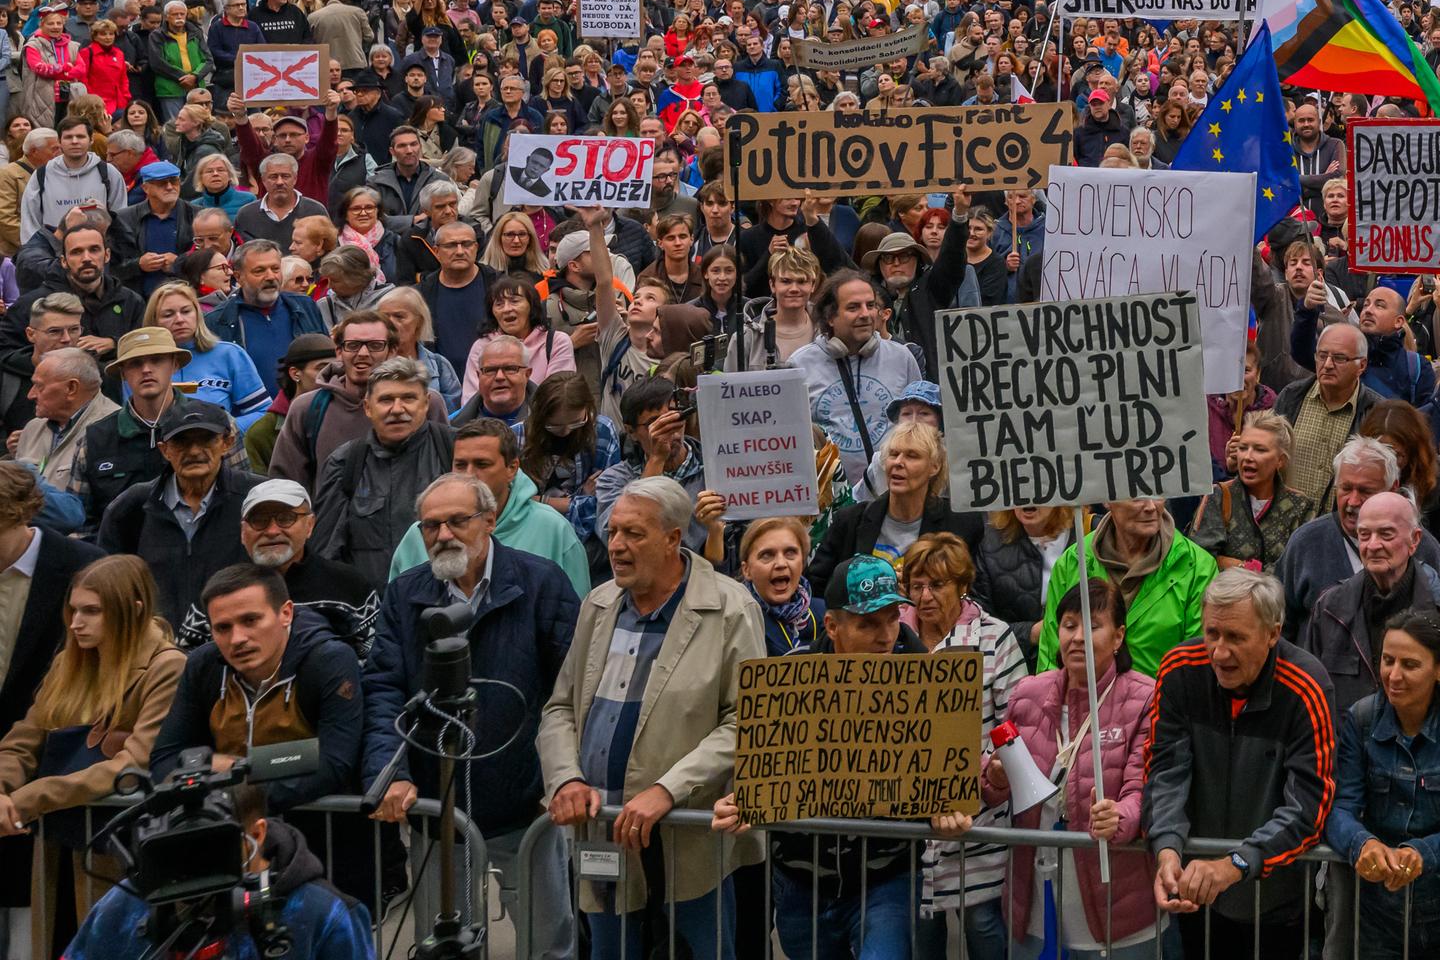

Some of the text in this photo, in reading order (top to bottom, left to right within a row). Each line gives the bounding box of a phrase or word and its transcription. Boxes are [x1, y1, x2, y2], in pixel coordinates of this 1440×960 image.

[554, 139, 654, 182] STOP
[1045, 182, 1193, 239] SLOVENSKO
[1355, 224, 1434, 263] +BONUS
[943, 290, 1197, 362] KDE VRCHNOSŤ
[721, 382, 781, 399] ŽI ALEBO
[946, 345, 1193, 412] VRECKO PLNÍ
[731, 410, 777, 426] SKAP,
[965, 409, 1056, 457] TAM
[717, 436, 797, 455] ALE FICOVI
[726, 461, 794, 479] NAJVYŠŠIE
[967, 429, 1197, 508] BIEDU TRPÍ
[765, 484, 811, 505] PLAŤ!
[739, 658, 978, 690] OPOZICIA JE SLOVENSKO
[741, 688, 980, 721] DEMOKRATI, SAS A KDH.
[737, 719, 932, 750] MOŽNO SLOVENSKO
[736, 747, 970, 781] ZOBERIE DO VLADY AJ PS
[736, 783, 763, 810] ALE
[768, 781, 790, 806] TO
[796, 779, 816, 803] SA
[821, 778, 861, 803] MUSI
[909, 775, 980, 802] ŠIMEČKA
[773, 806, 788, 822] TO
[890, 800, 955, 816] NEBUDE.
